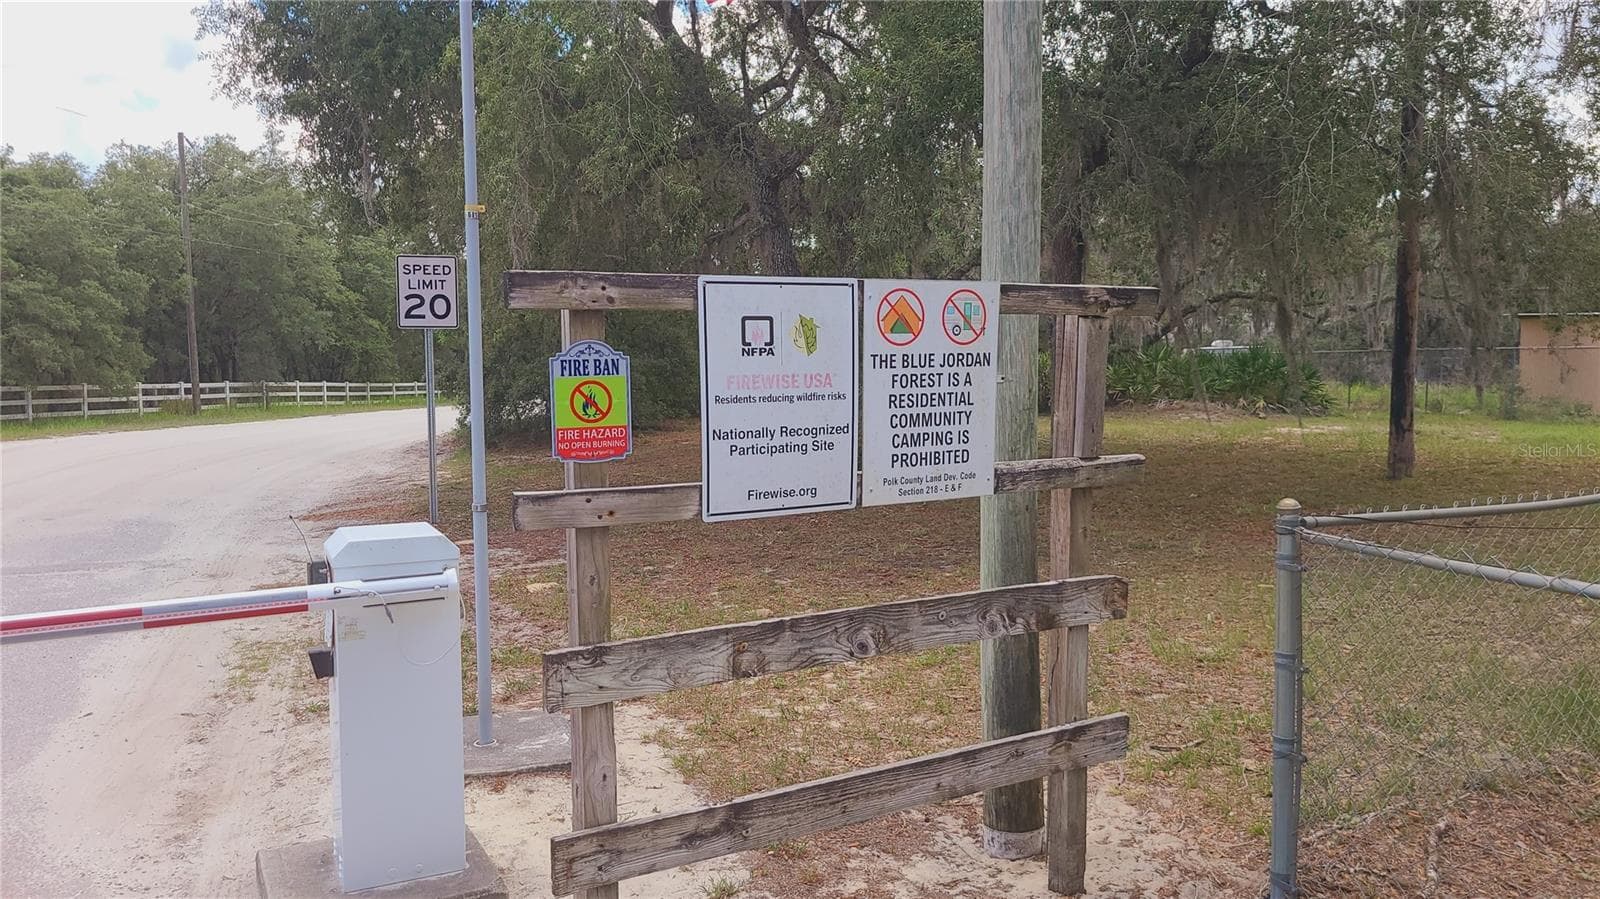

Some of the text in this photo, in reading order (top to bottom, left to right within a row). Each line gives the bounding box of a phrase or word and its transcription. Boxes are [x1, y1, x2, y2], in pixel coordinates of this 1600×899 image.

[402, 264, 451, 276] SPEED
[408, 279, 446, 290] LIMIT
[404, 294, 452, 320] 20
[741, 347, 775, 357] NFPA
[870, 352, 991, 369] THE BLUE JORDAN
[560, 358, 620, 377] FIRE BAN
[725, 373, 833, 390] FIREWISE USA
[891, 371, 972, 389] FOREST IS A
[714, 391, 847, 405] Residents reducing wildfire risks
[888, 392, 974, 409] RESIDENTIAL
[889, 411, 973, 429] COMMUNITY
[558, 428, 626, 441] FIRE HAZARD
[712, 423, 849, 441] Nationally Recognized
[891, 430, 970, 448] CAMPING IS
[558, 439, 626, 450] NO OPEN BURNING
[729, 440, 835, 457] Participating Site
[890, 449, 970, 468] PROHIBITED
[883, 471, 977, 487] Polk County Land Dev. Code
[747, 486, 818, 501] Firewise.org
[898, 487, 925, 497] Section
[925, 486, 940, 495] 218
[944, 484, 950, 493] E
[950, 483, 957, 493] &
[957, 482, 963, 492] F
